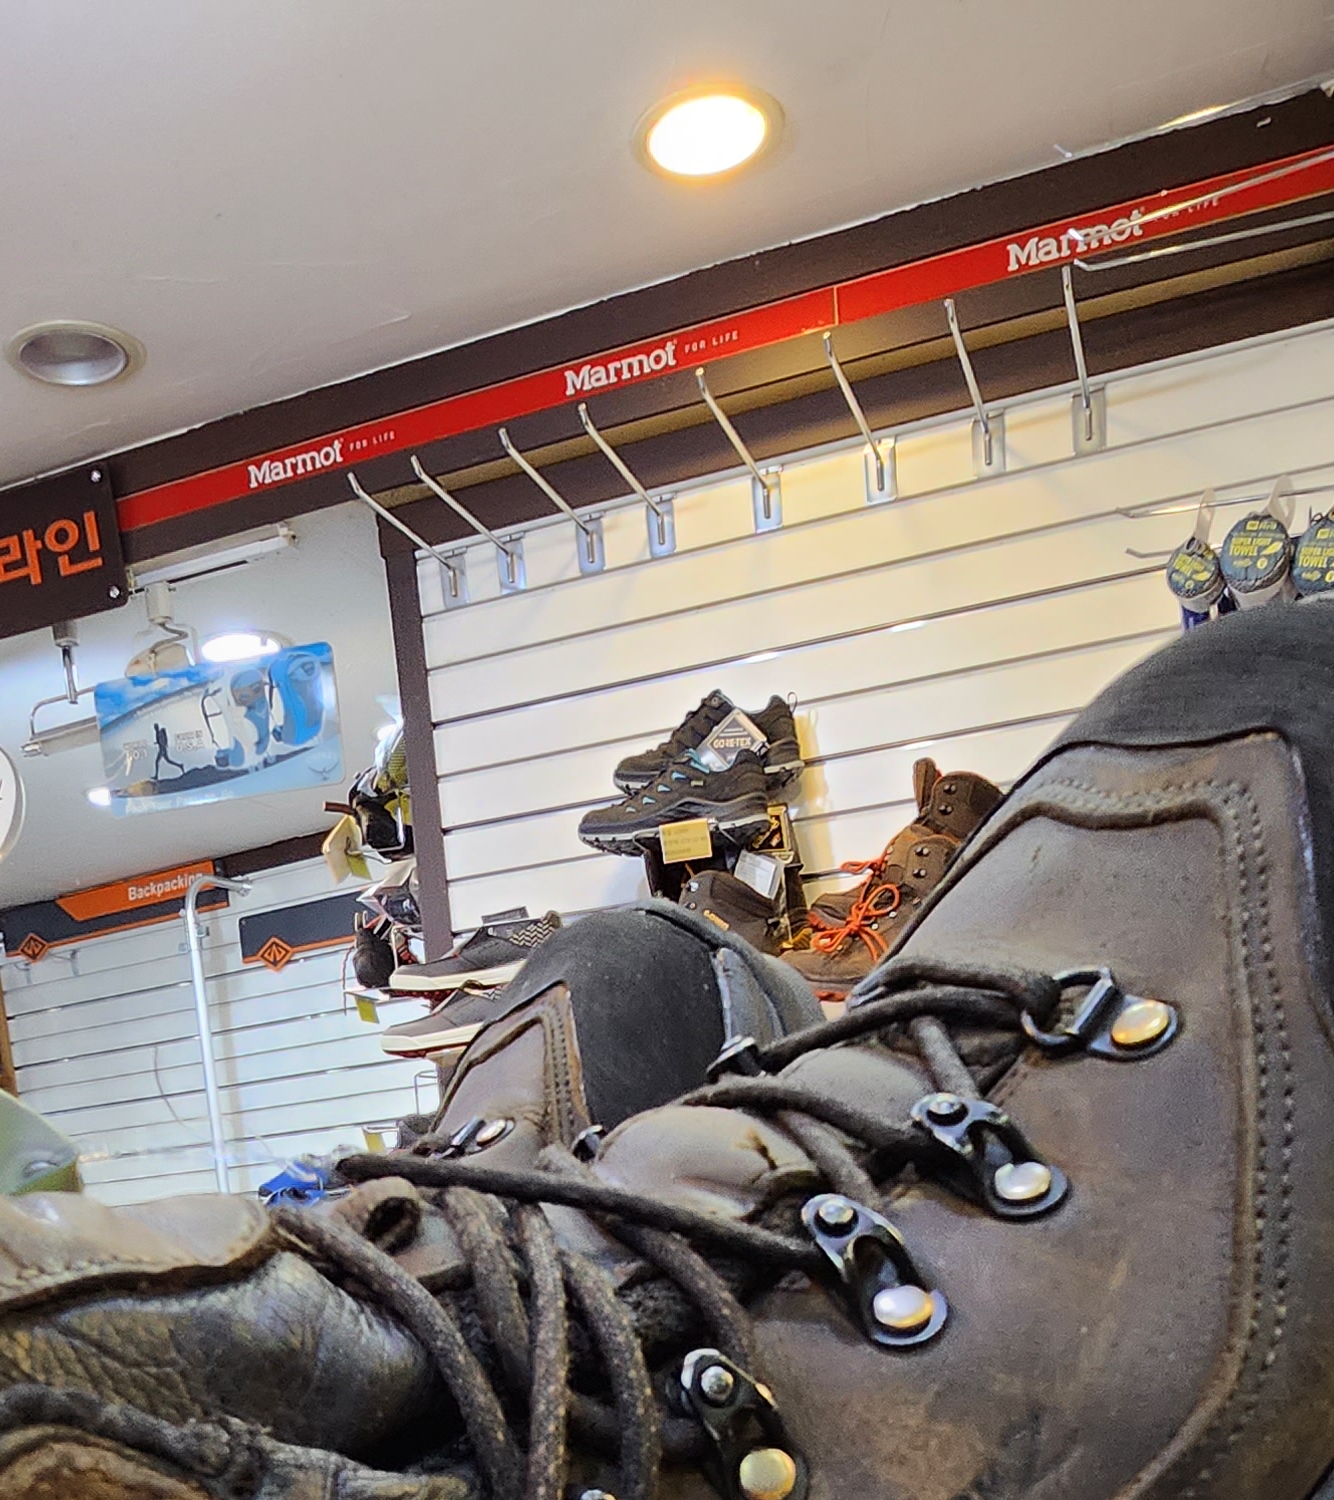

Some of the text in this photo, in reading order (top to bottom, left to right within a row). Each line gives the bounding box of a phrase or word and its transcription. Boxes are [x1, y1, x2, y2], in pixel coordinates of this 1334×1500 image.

[564, 329, 740, 396] Marmot FOR LIFE
[248, 430, 396, 489] Marmot FOR LIFE
